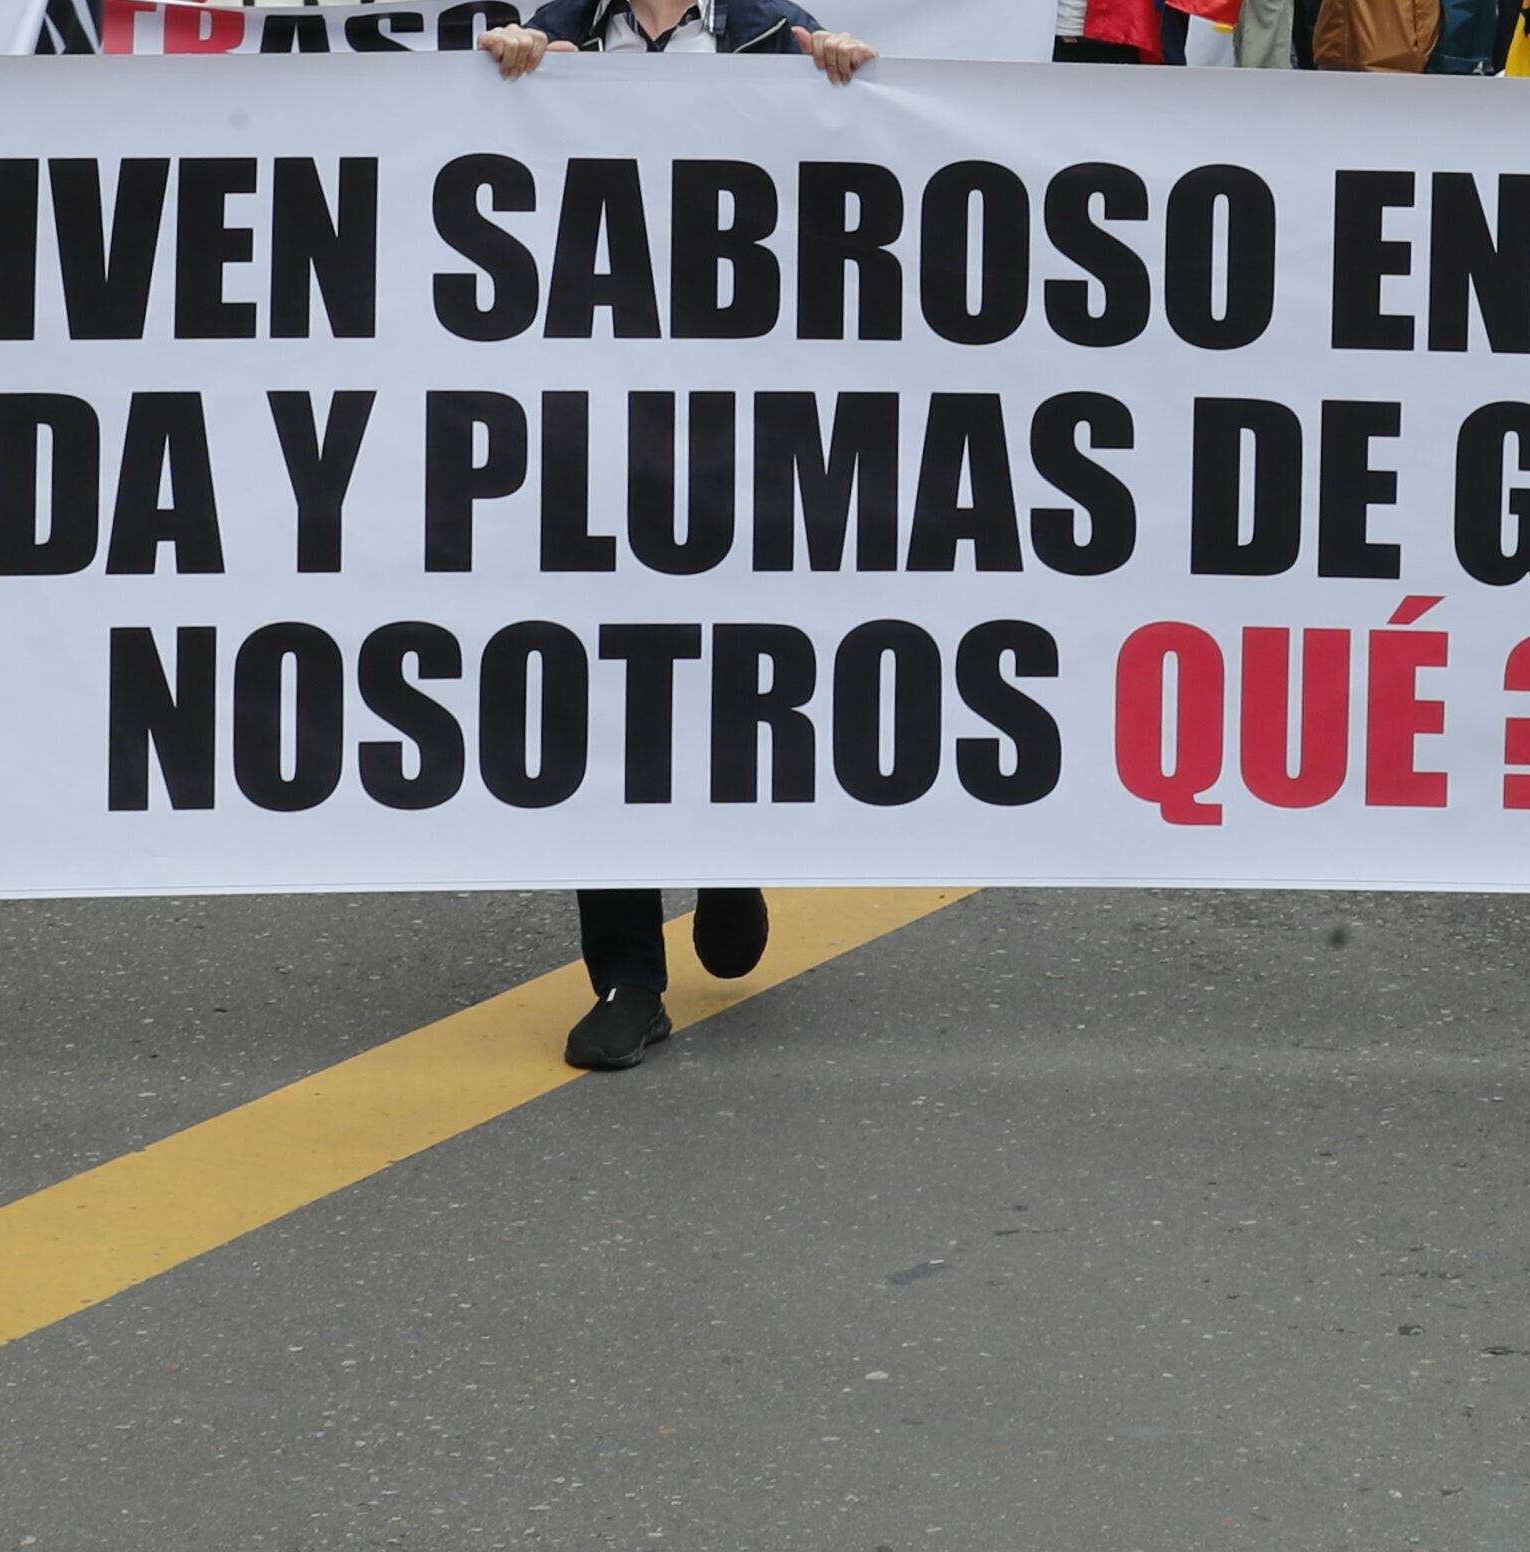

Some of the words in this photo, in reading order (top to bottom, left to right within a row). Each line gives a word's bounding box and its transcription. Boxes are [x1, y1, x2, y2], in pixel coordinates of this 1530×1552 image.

[432, 153, 1276, 351] SABROSO
[267, 390, 377, 574] Y
[424, 390, 1137, 577] PLUMAS
[1190, 396, 1402, 580] DE
[108, 619, 1062, 813] NOSOTROS
[1115, 595, 1449, 826] QUÉ
